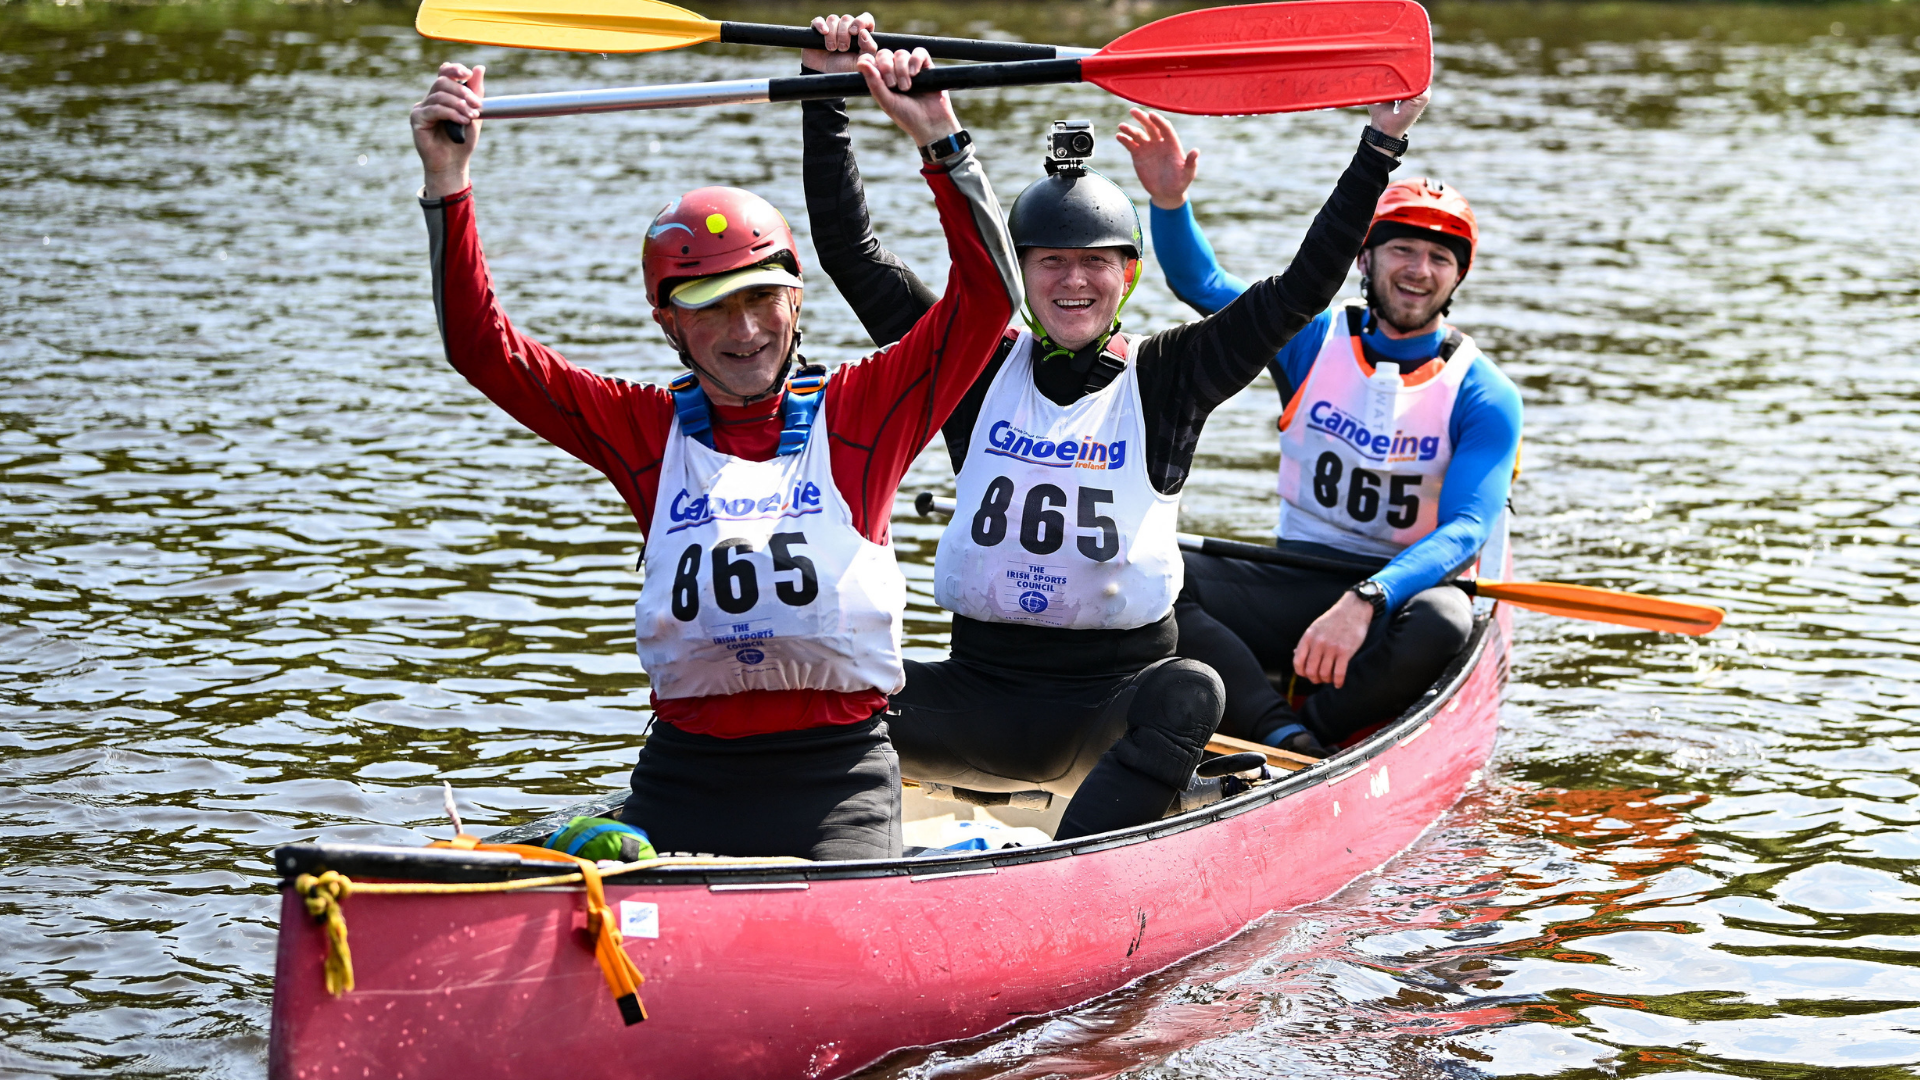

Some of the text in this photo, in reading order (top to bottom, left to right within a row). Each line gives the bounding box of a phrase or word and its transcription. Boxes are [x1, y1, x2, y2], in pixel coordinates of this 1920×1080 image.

[1310, 400, 1440, 462] Canoeing
[988, 420, 1126, 470] Canoeing
[1074, 461, 1106, 470] Ireland
[1313, 451, 1423, 529] 865
[971, 476, 1119, 562] 865
[1029, 565, 1045, 573] THE
[671, 532, 818, 622] 865
[1006, 570, 1067, 584] IRISH SPORTS
[1017, 580, 1054, 591] COUNCIL
[732, 623, 749, 633] THE
[713, 629, 774, 645] IRISH SPORTS
[726, 641, 764, 650] COUNCIL
